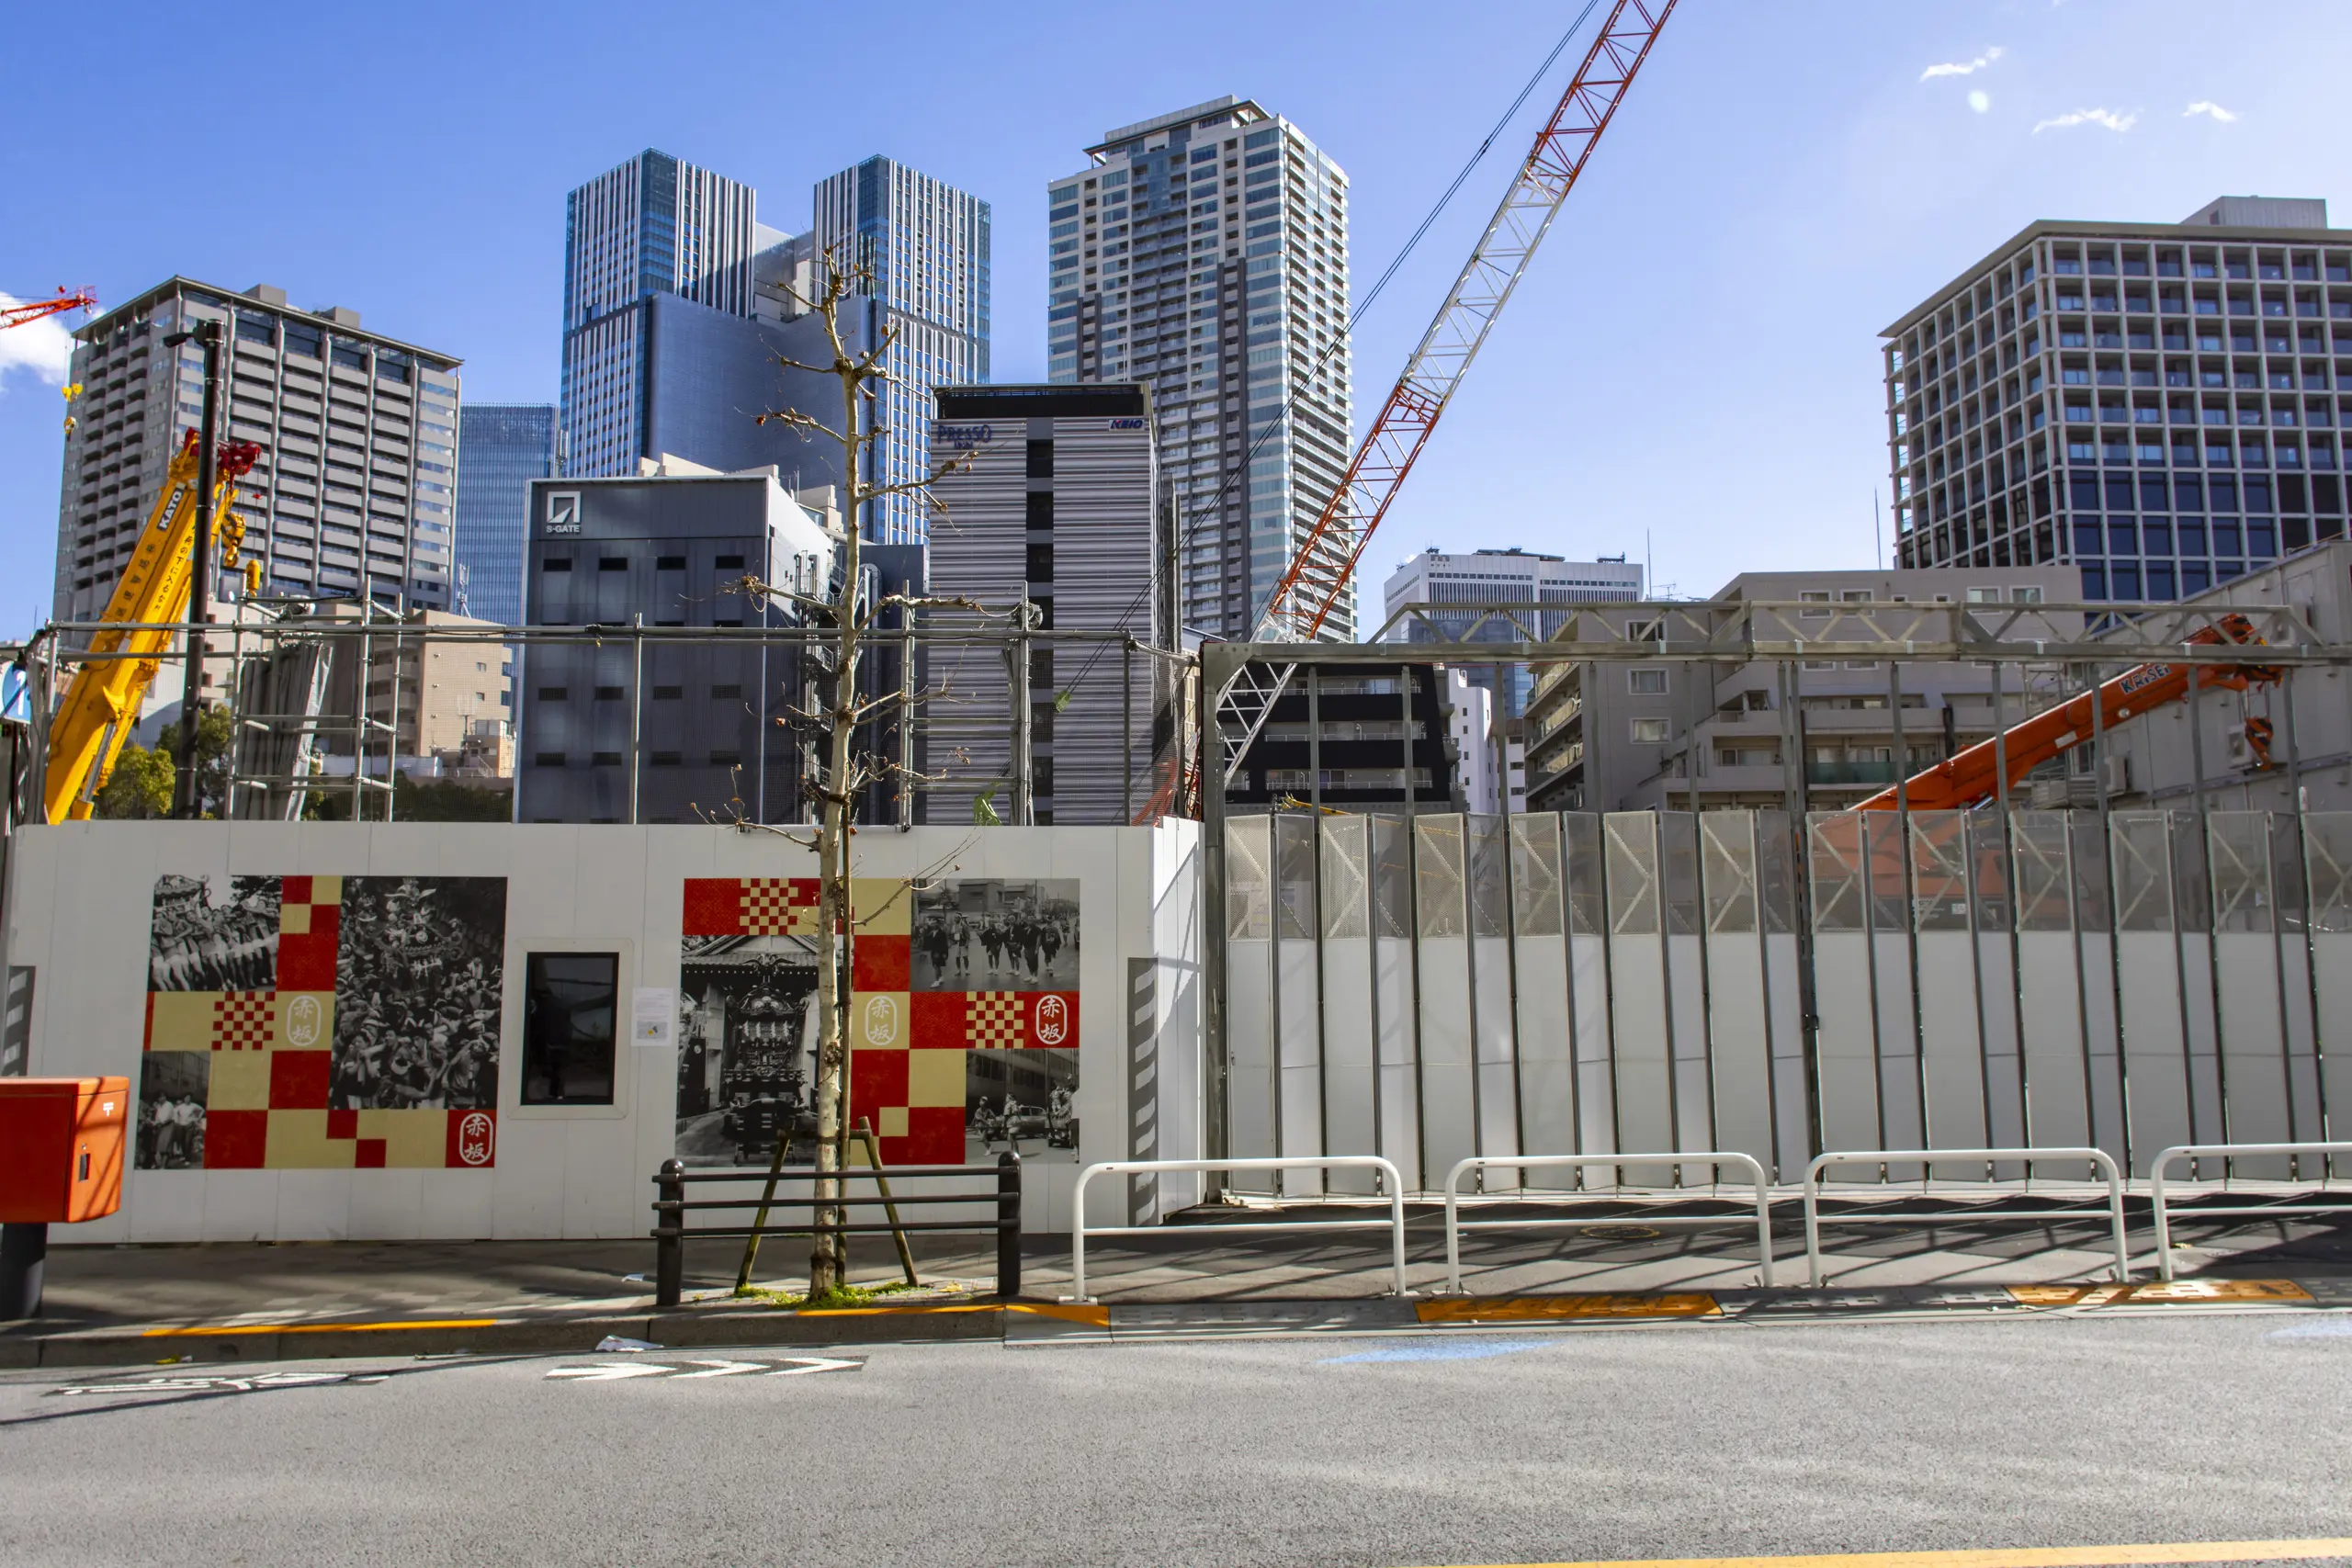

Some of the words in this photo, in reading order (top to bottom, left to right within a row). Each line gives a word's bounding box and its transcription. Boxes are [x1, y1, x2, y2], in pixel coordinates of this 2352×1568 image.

[1110, 419, 1144, 429] KEIO
[158, 491, 183, 529] KATO
[546, 525, 581, 533] S-GATE
[293, 998, 314, 1041] 赤坂
[869, 998, 891, 1041] 赤坂
[1040, 998, 1061, 1040] 赤坂
[464, 1115, 486, 1160] 赤坂
